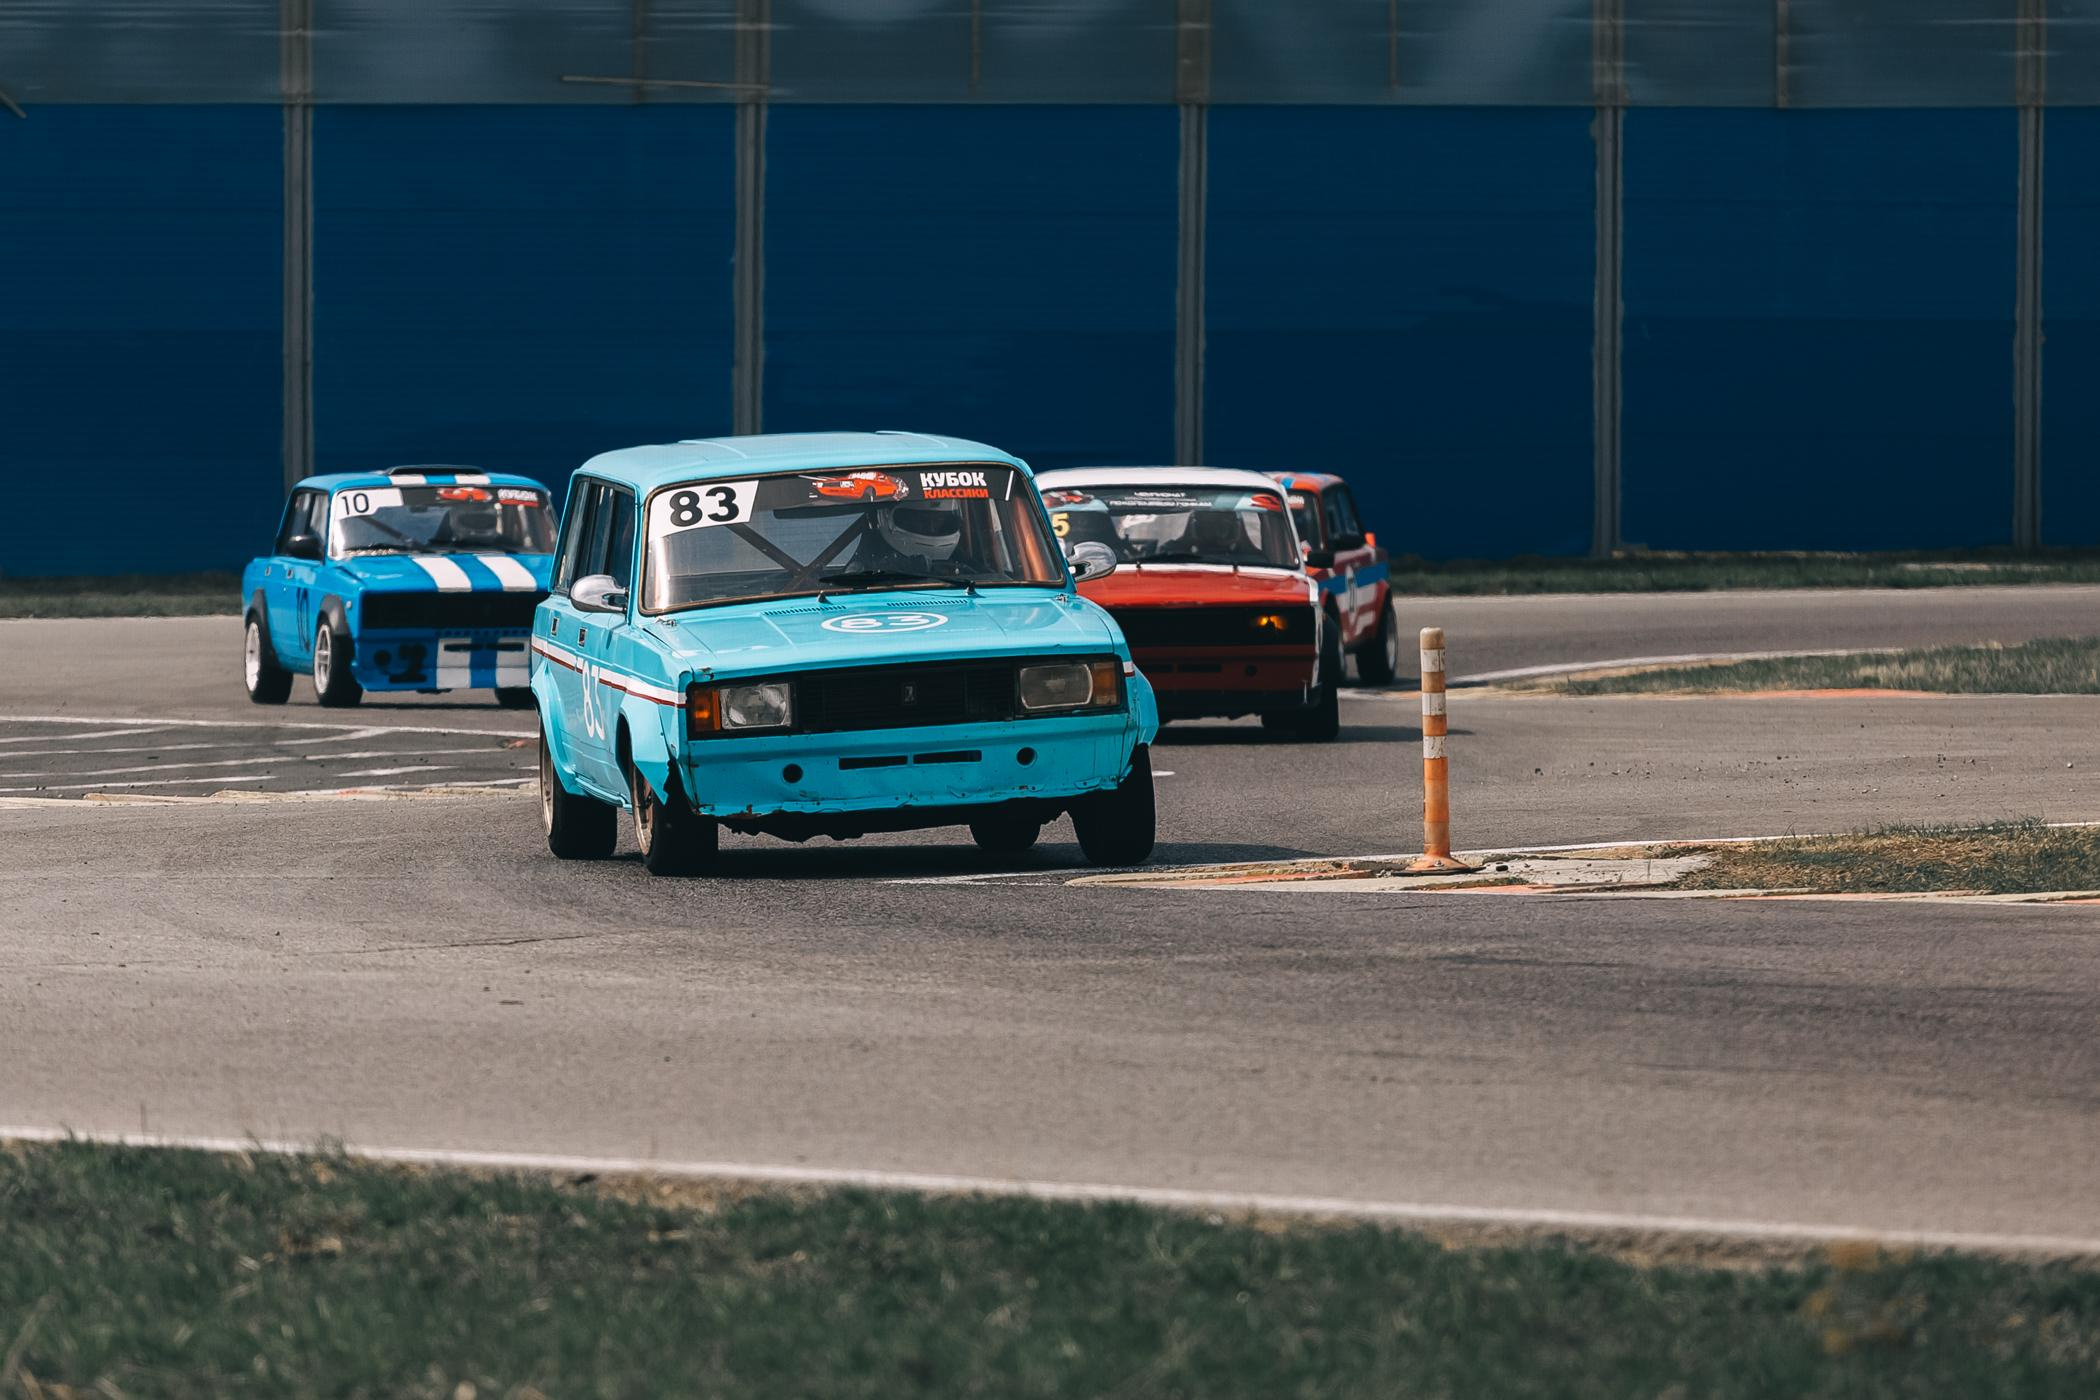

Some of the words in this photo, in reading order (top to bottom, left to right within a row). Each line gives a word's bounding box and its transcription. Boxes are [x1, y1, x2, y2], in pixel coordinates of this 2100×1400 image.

[920, 472, 987, 487] КУБОК
[923, 487, 989, 498] КЛАССИКИ
[342, 493, 370, 515] 10
[669, 486, 739, 527] 83
[840, 615, 930, 629] 83
[582, 660, 605, 740] 83
